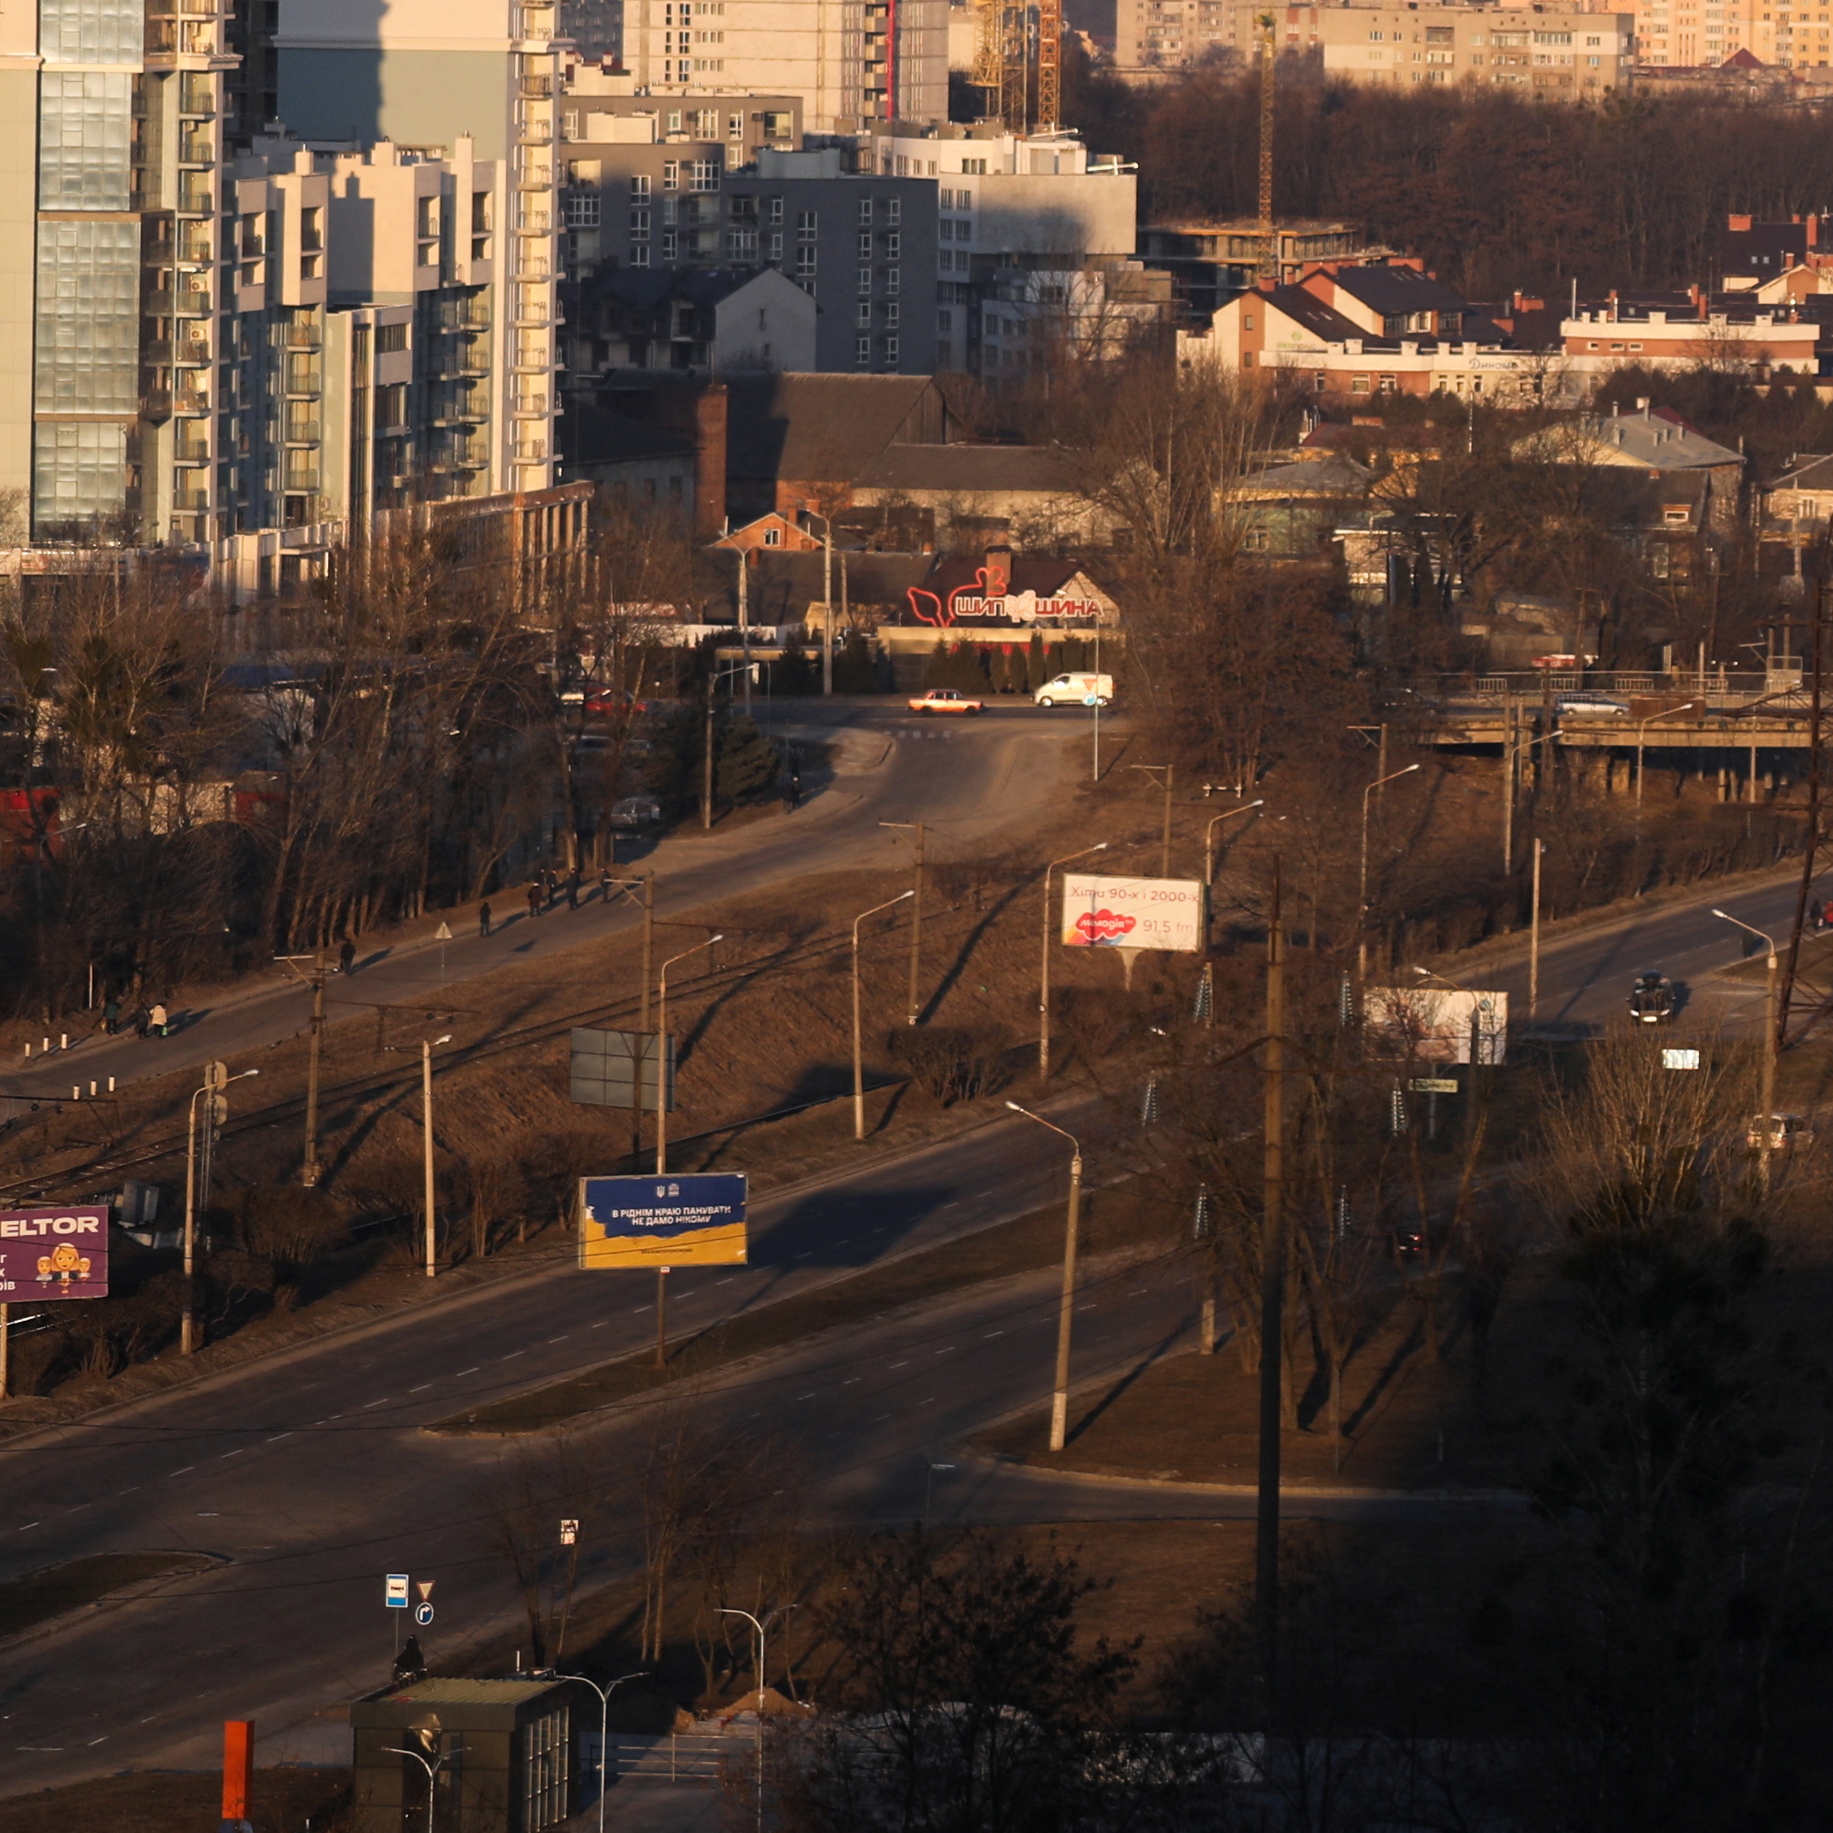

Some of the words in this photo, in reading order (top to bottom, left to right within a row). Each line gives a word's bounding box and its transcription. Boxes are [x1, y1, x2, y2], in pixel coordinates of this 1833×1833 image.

[612, 1210, 619, 1218] В
[620, 1208, 653, 1219] РІДНІМ
[655, 1207, 682, 1216] КРАЮ
[632, 1217, 644, 1225] НЕ
[645, 1216, 674, 1226] ДАМО
